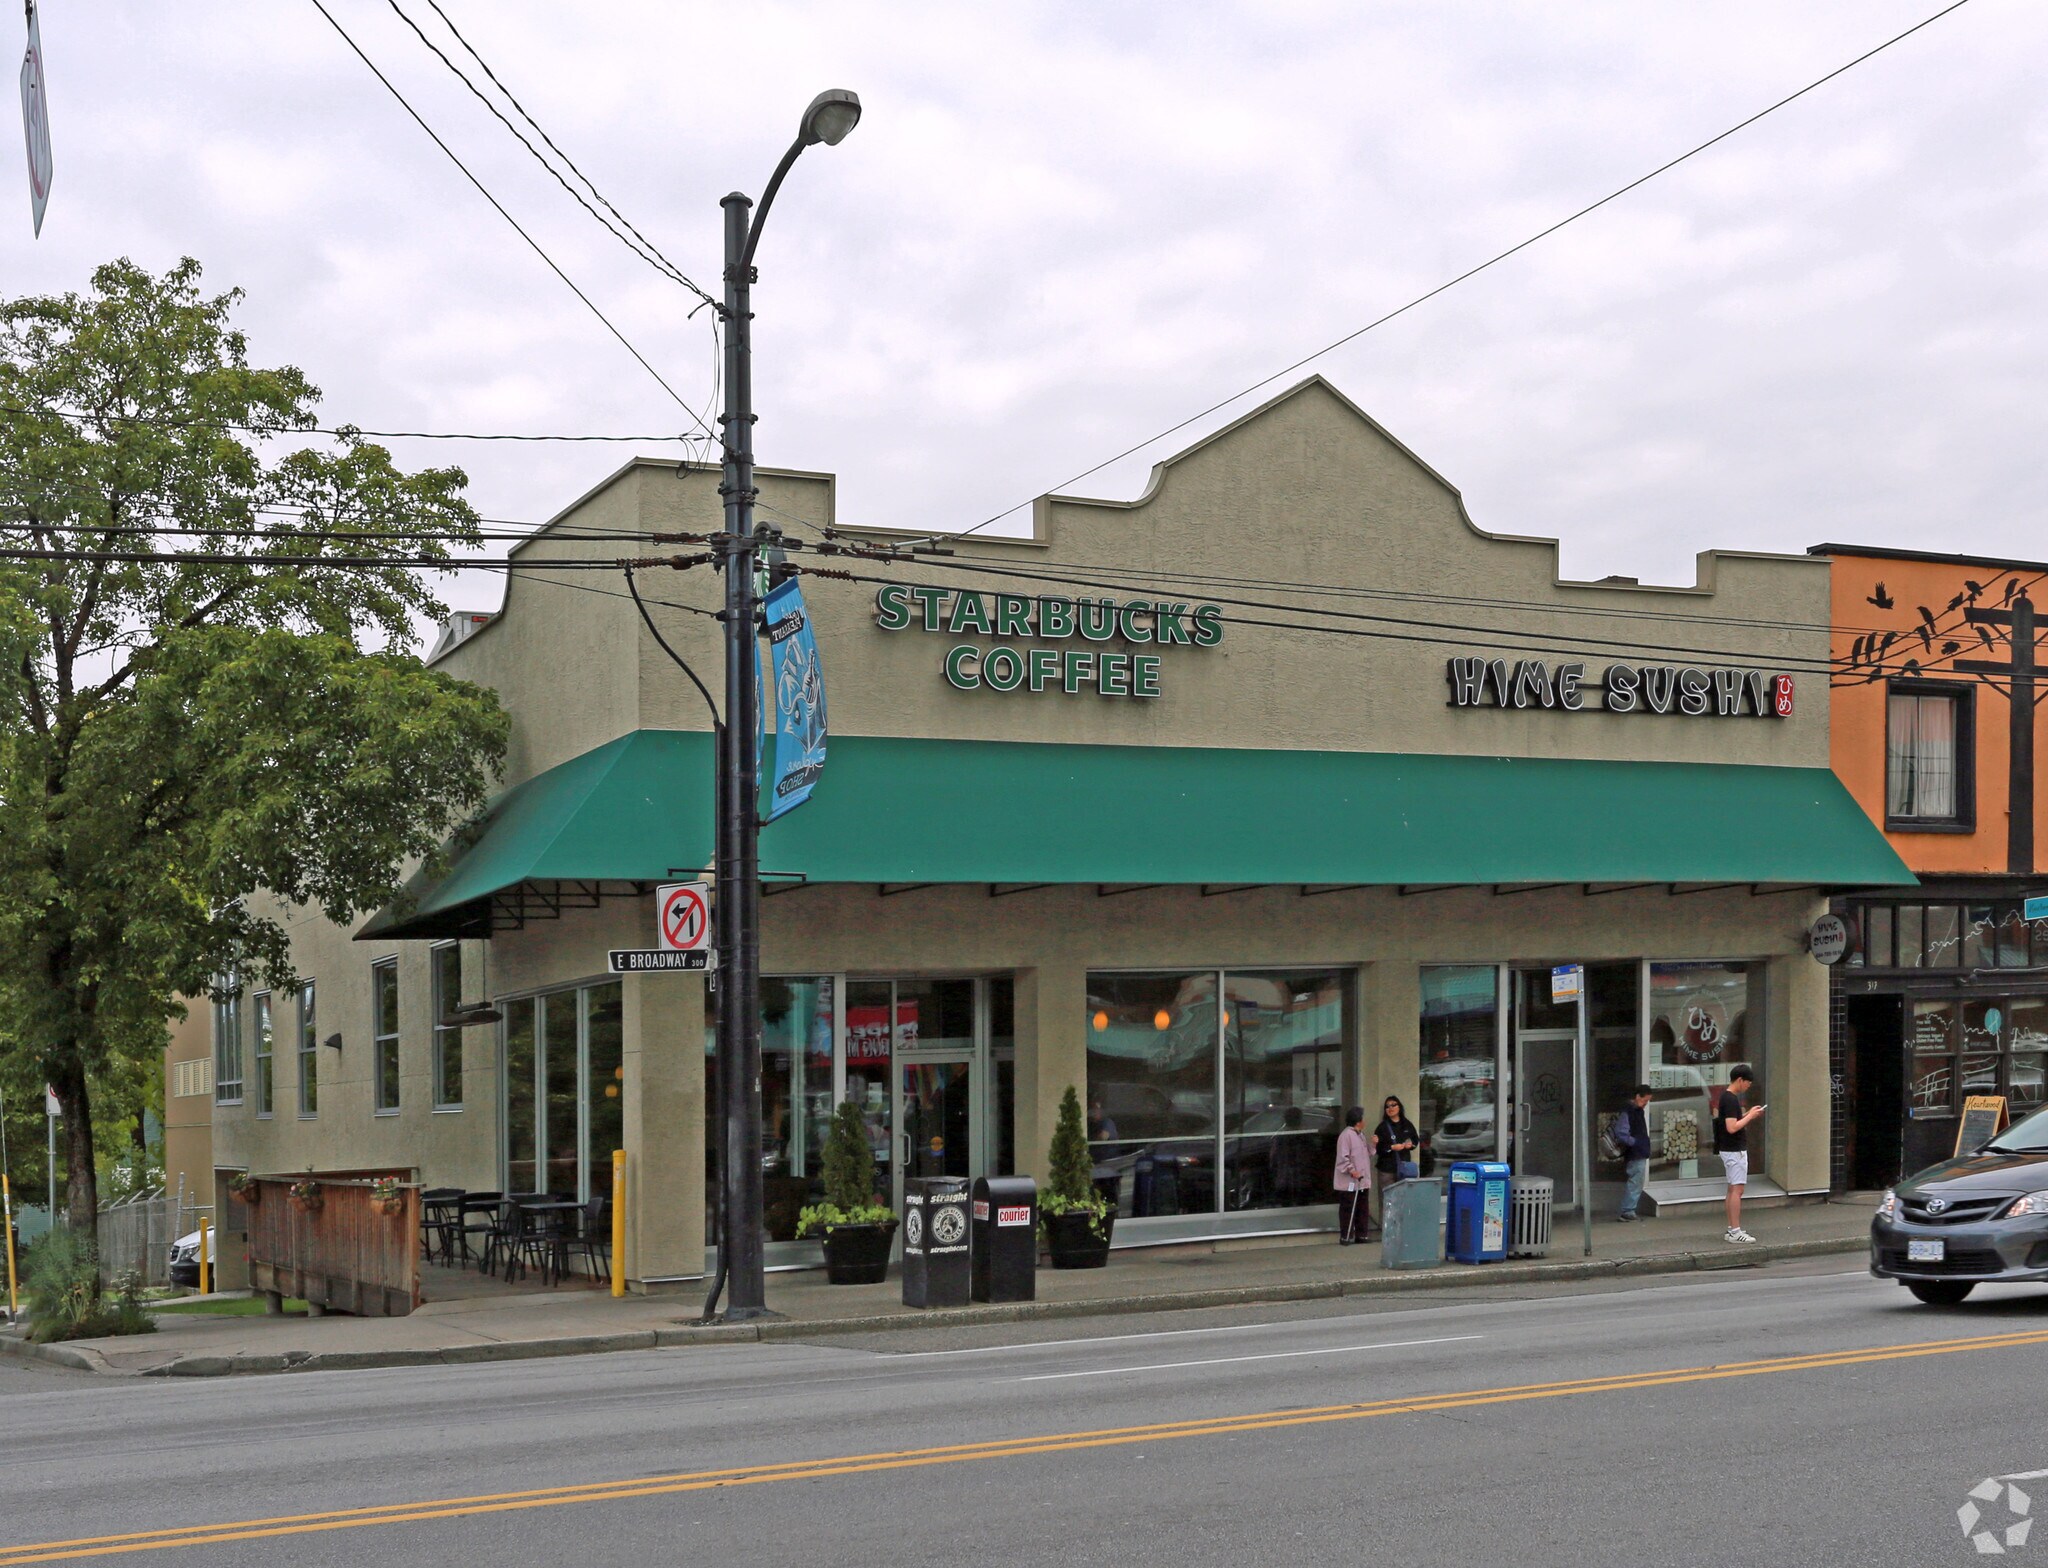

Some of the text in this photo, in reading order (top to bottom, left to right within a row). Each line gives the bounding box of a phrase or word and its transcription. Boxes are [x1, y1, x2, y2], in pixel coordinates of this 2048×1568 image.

[875, 583, 1224, 647] STARBUCKS
[943, 644, 1161, 698] COFFEE
[1448, 656, 1764, 716] HIME SUSHI
[1777, 677, 1793, 713] ひめ
[617, 953, 704, 968] E BROADWAY 300
[1678, 1034, 1728, 1061] HIME SUSHI
[930, 1192, 967, 1203] straight
[1000, 1208, 1029, 1222] courier
